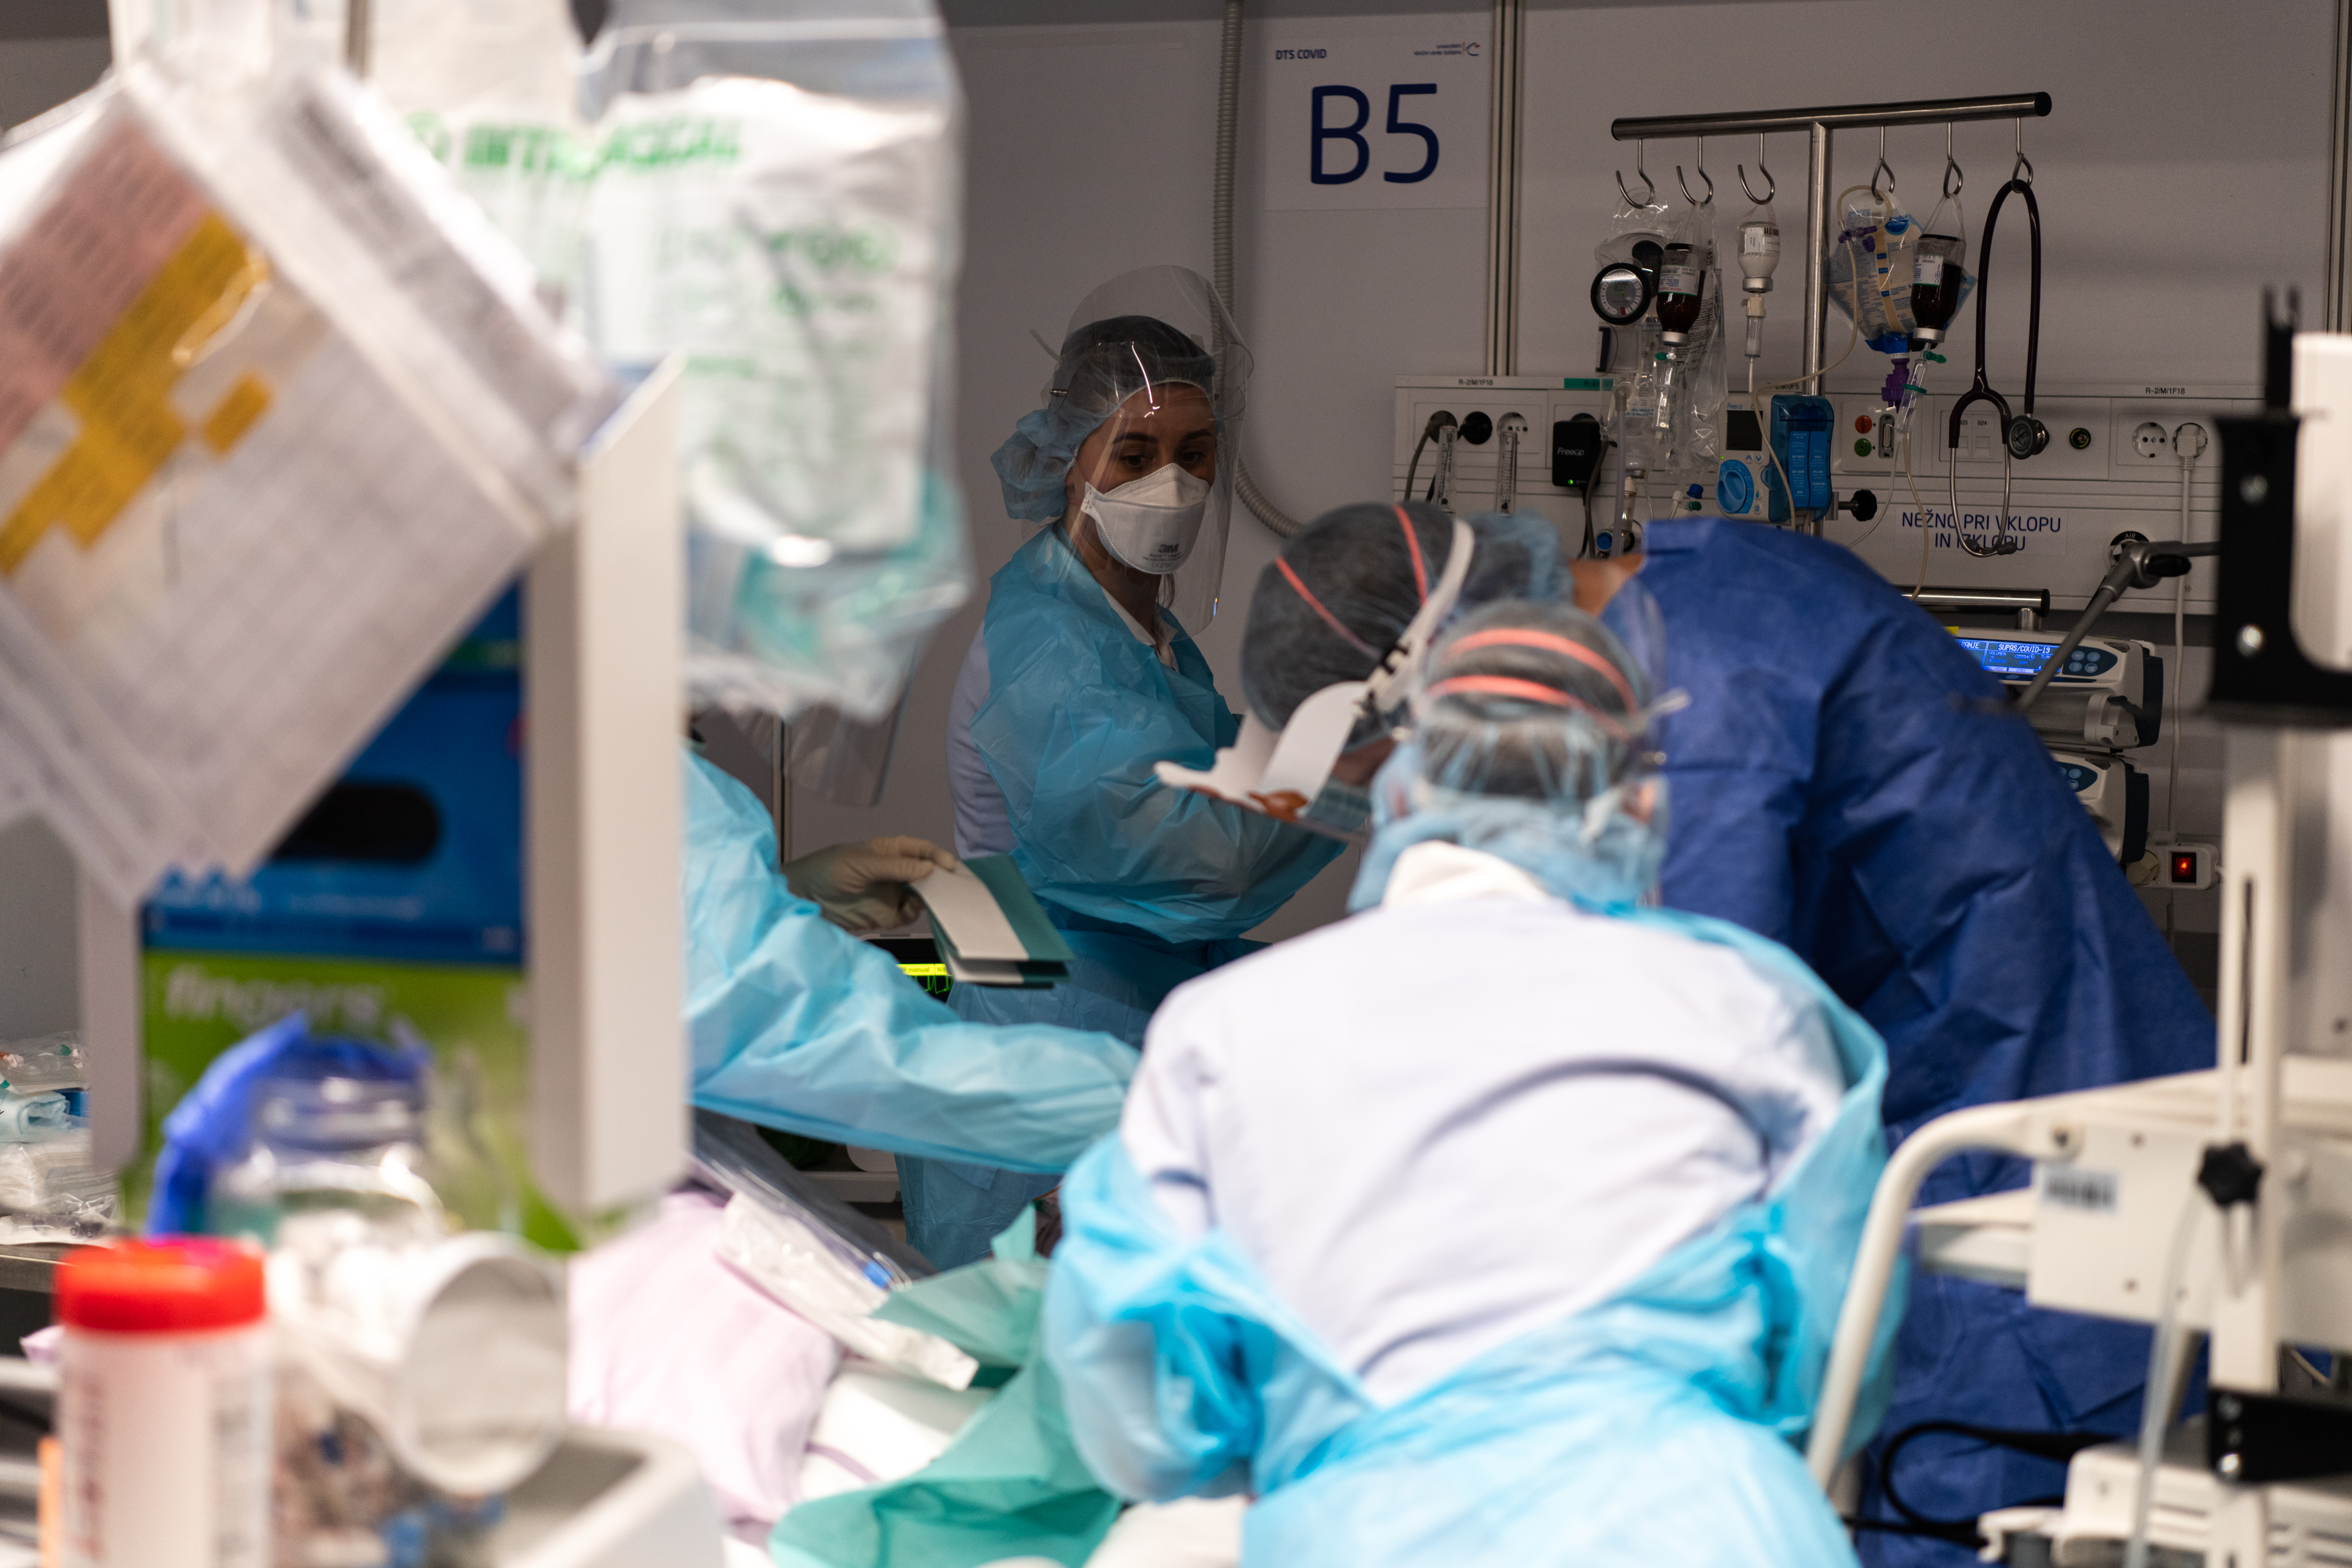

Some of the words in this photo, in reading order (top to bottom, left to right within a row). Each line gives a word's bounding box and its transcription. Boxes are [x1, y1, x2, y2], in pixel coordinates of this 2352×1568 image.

[1276, 50, 1295, 60] DTS
[1297, 48, 1327, 59] COVID
[1311, 83, 1439, 185] B5
[1964, 514, 1990, 529] PRI
[1935, 533, 1951, 548] IN
[1158, 543, 1179, 553] 3M
[1998, 643, 2051, 654] SUPAS/COVID-19
